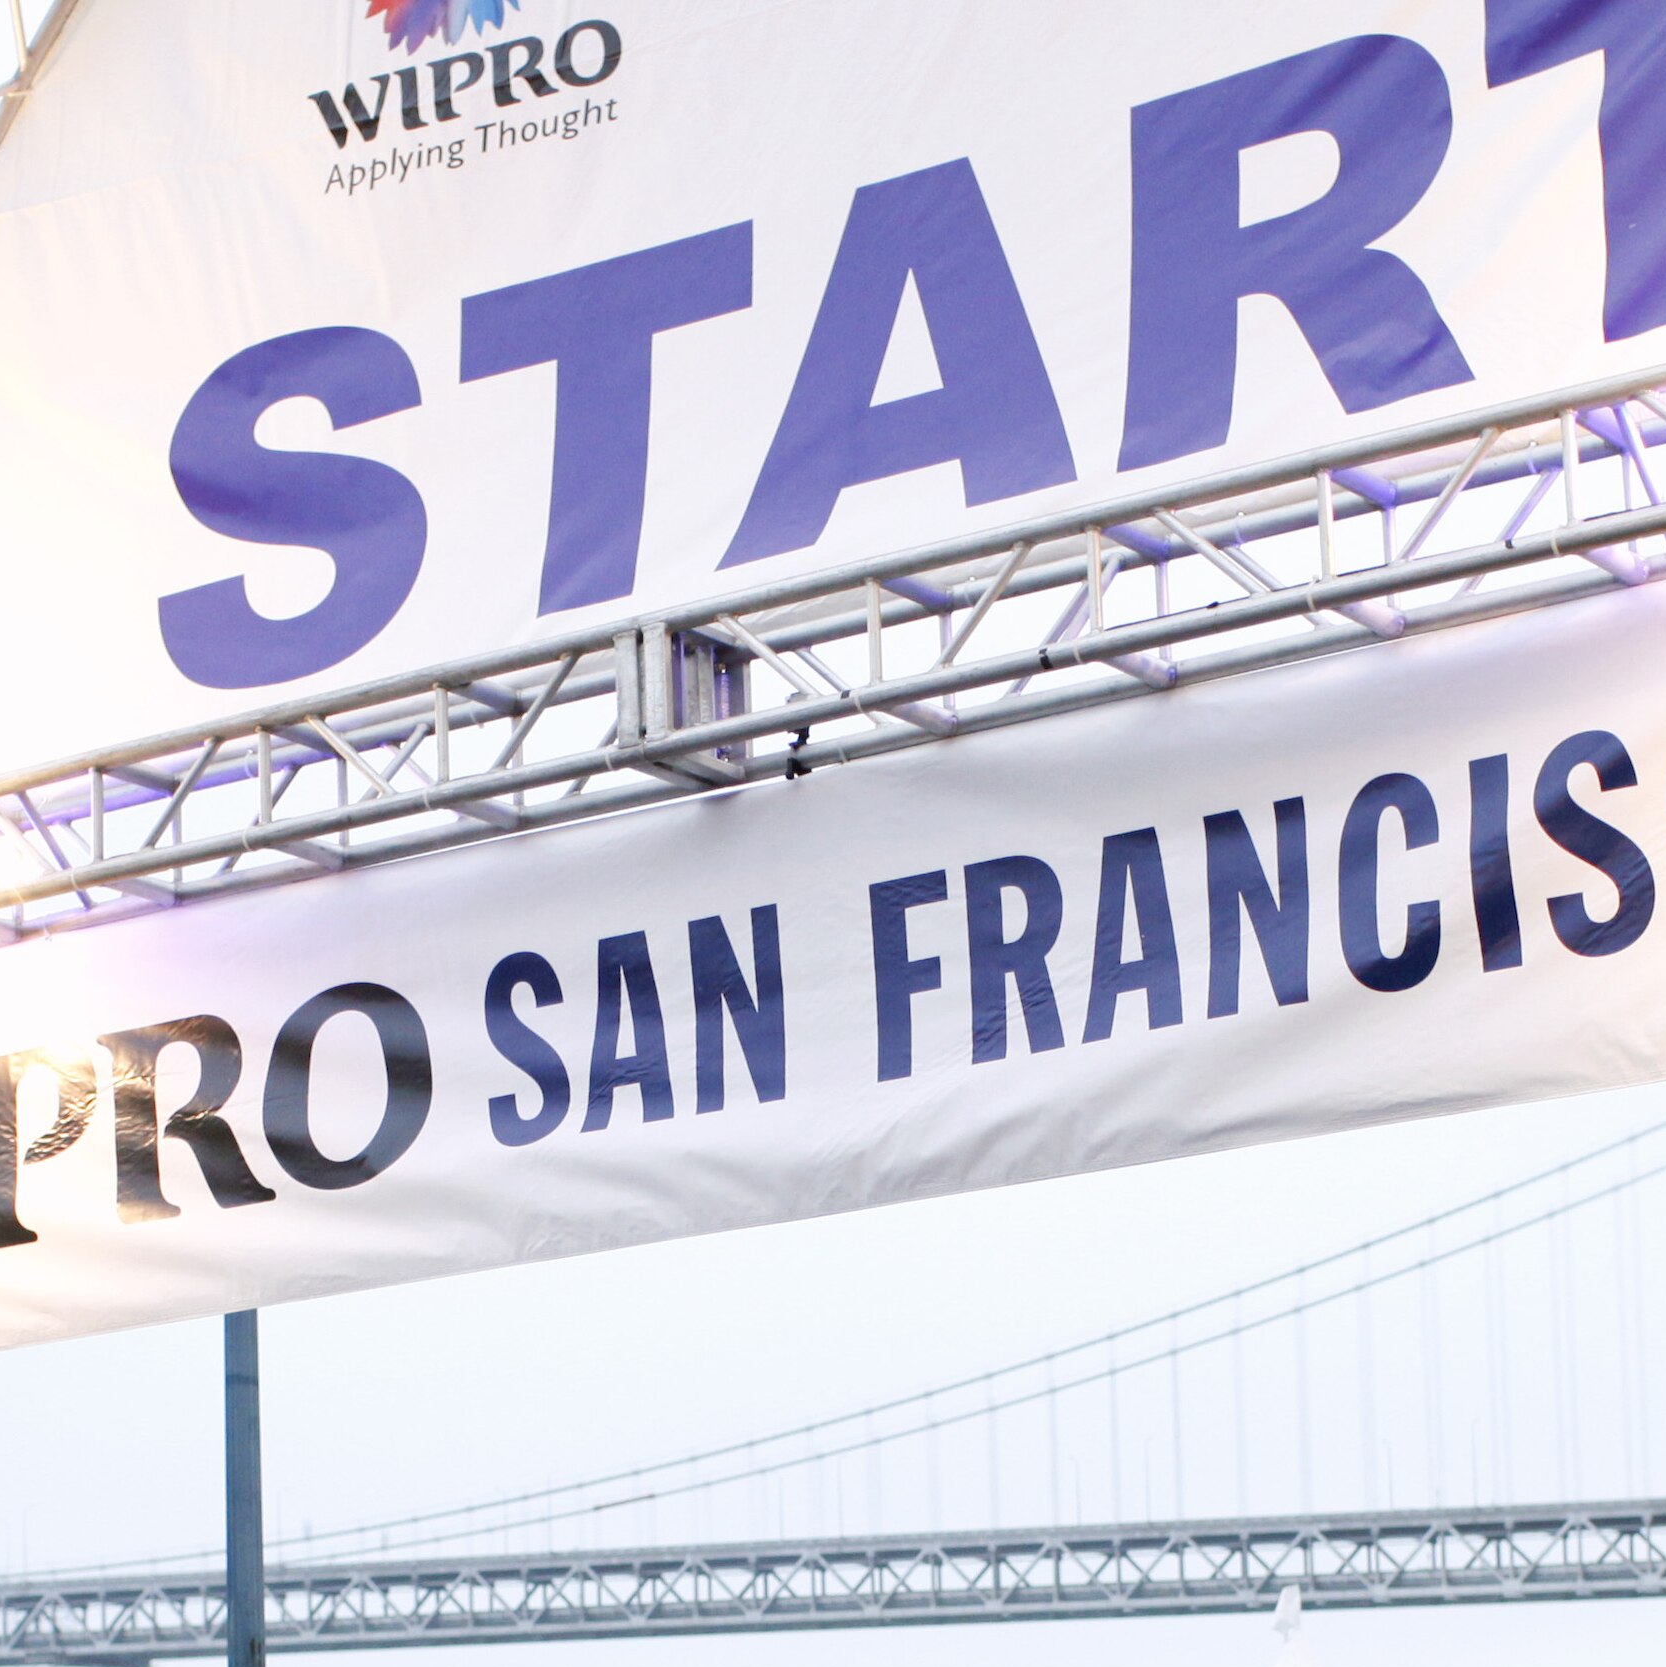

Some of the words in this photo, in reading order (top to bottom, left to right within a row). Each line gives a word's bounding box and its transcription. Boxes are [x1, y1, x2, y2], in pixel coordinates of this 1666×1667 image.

[307, 19, 622, 150] WIPRO
[324, 137, 466, 196] Applying
[474, 98, 619, 153] Thought
[483, 905, 787, 1148] SAN
